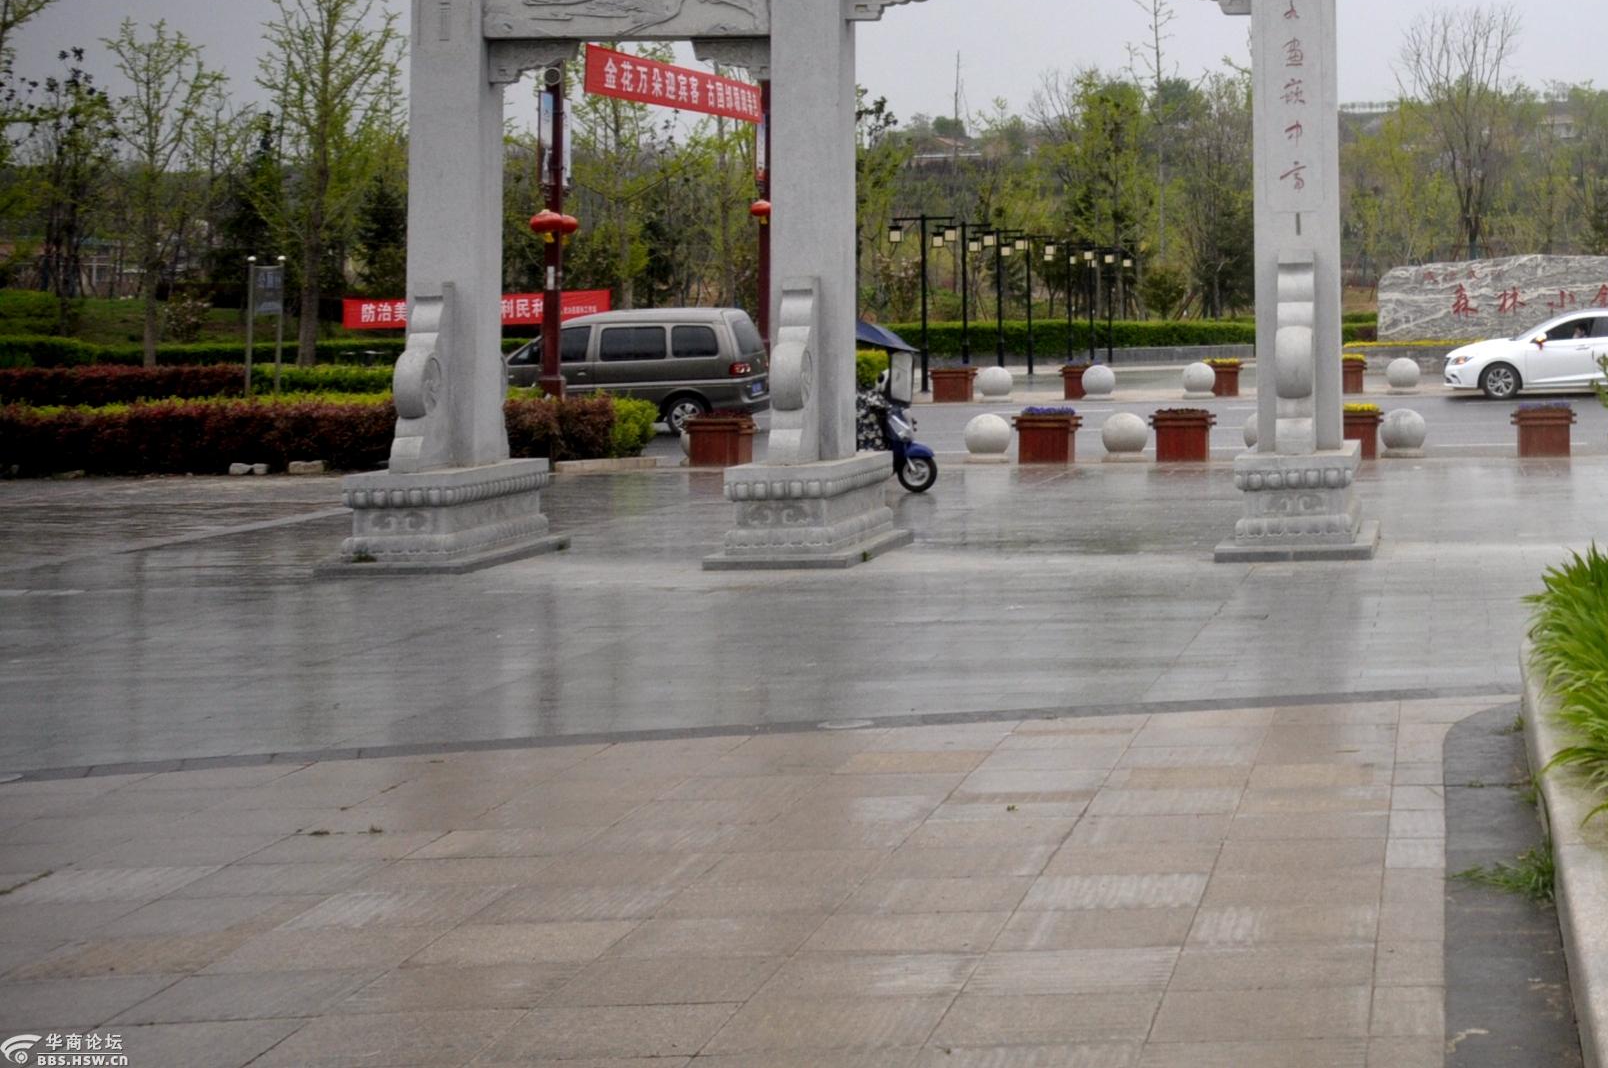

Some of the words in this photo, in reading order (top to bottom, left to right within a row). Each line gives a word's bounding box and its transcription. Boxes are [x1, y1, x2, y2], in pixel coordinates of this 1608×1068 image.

[604, 57, 699, 104] 金花万朵迎宾客
